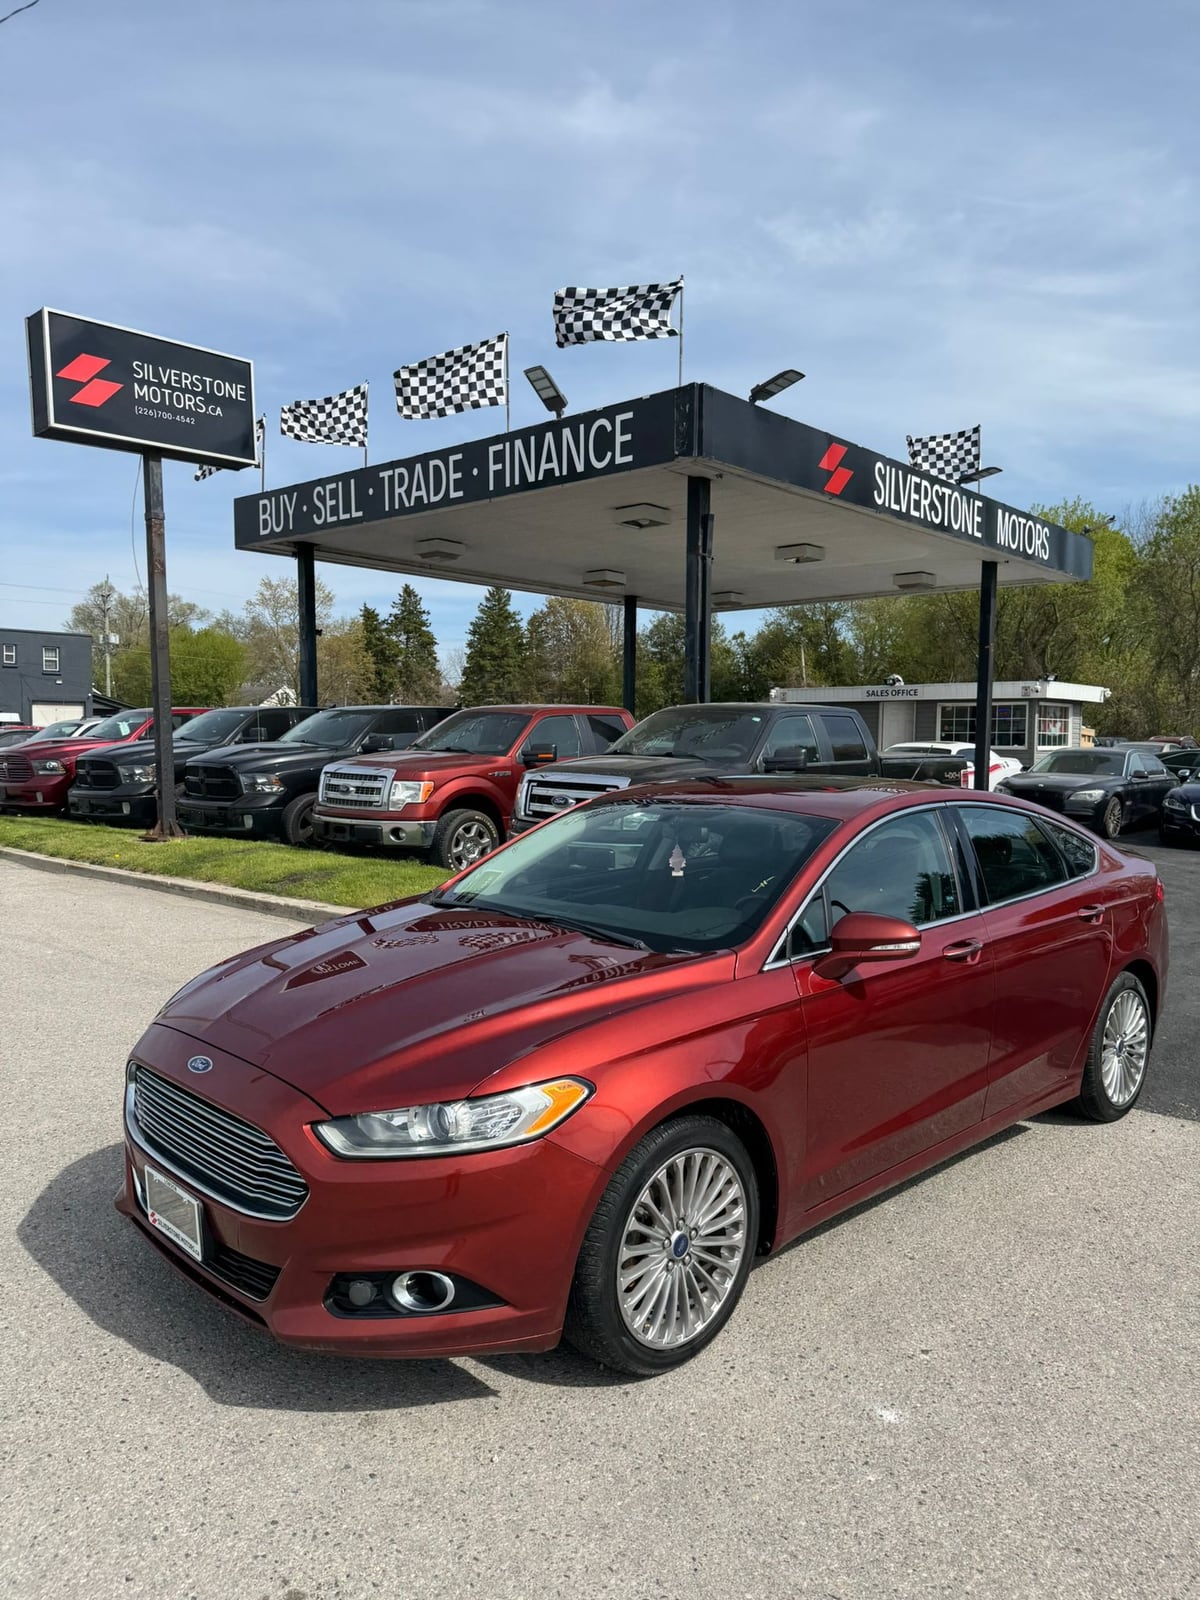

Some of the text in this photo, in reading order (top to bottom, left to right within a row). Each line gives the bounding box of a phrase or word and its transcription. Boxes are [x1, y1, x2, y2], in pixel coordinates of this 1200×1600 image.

[132, 361, 246, 402] SILVERSTONE
[135, 405, 196, 425] (226)700-4542
[259, 411, 634, 536] BUY SELL TRADE FINANCE
[873, 461, 1050, 560] SILVERSTONE MOTORS
[866, 688, 919, 698] SALES OFFICE
